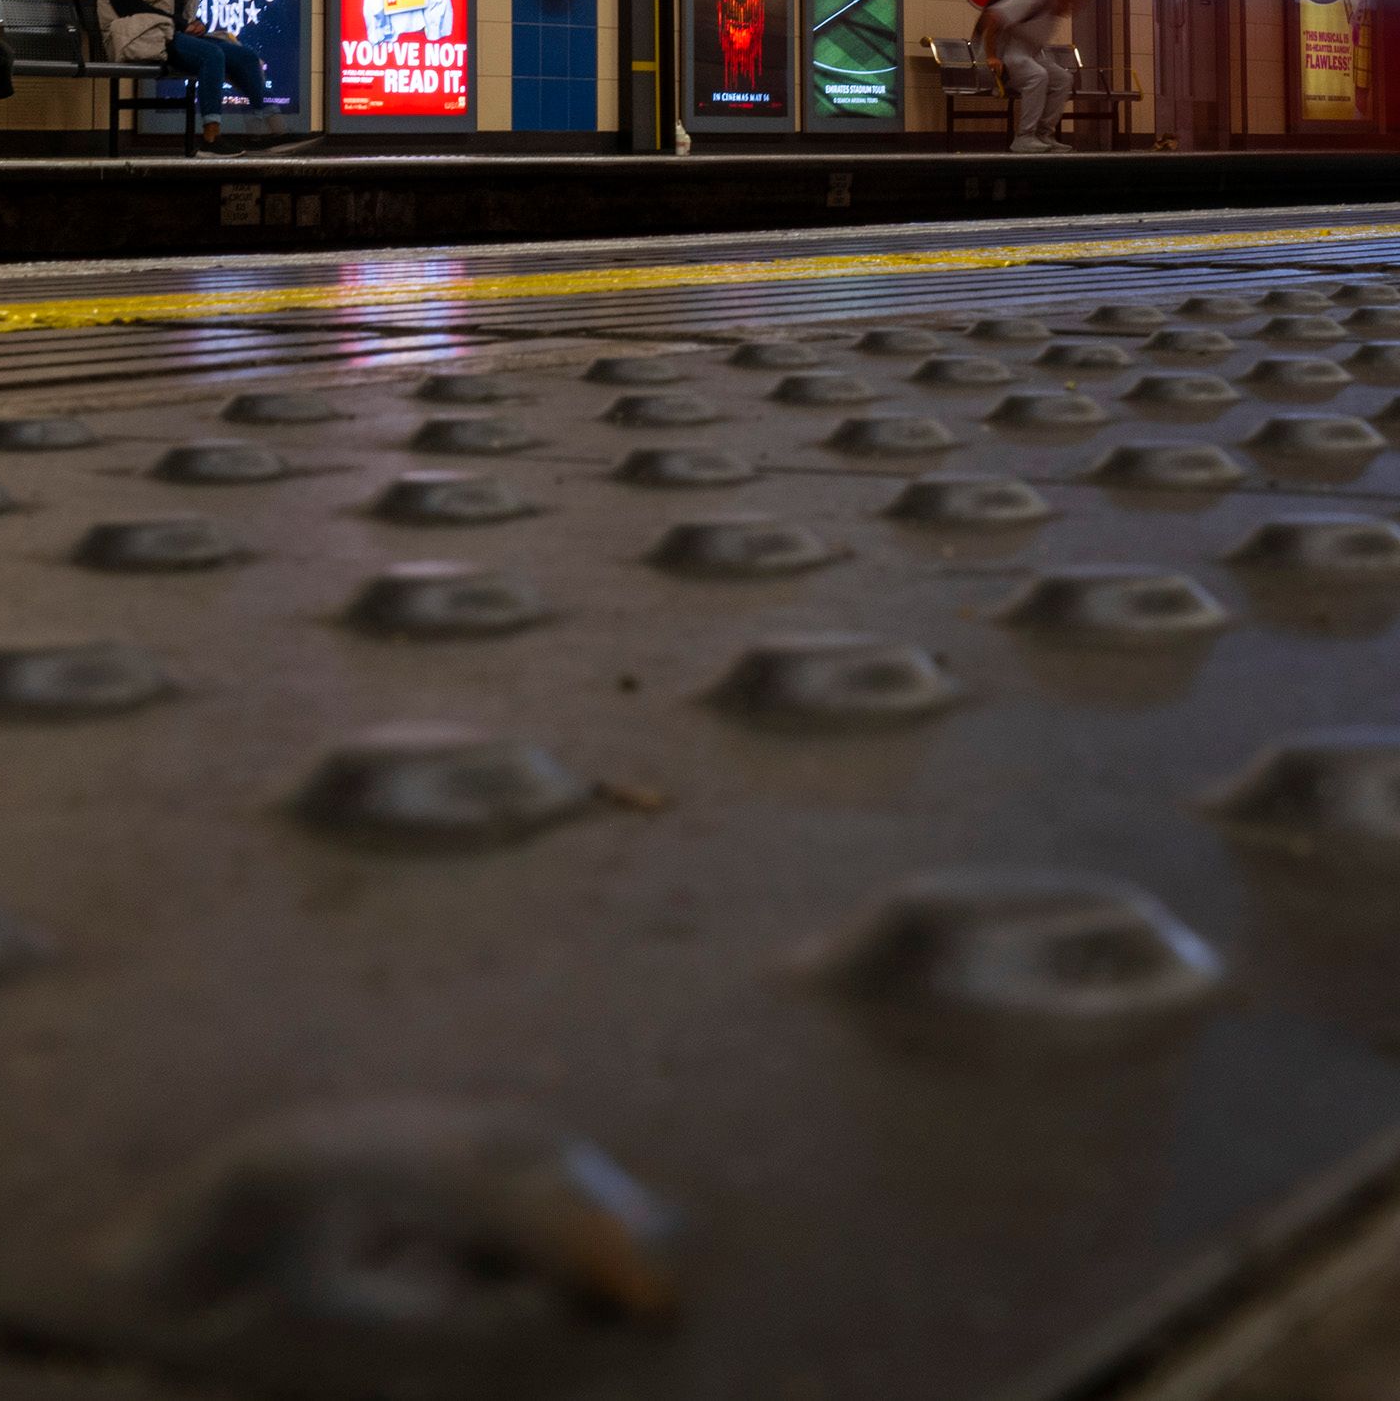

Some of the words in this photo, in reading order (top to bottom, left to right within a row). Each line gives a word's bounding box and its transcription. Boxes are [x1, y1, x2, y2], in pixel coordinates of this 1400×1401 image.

[342, 40, 420, 66] YOU'VE
[424, 42, 467, 67] NOT
[384, 69, 439, 93] READ
[443, 70, 466, 94] IT.
[825, 84, 849, 94] EMIRATES
[849, 84, 872, 95] STADIUM
[872, 85, 886, 94] TOUR
[712, 92, 720, 101] IN
[721, 92, 749, 102] CINEMAS
[749, 93, 763, 101] MAY
